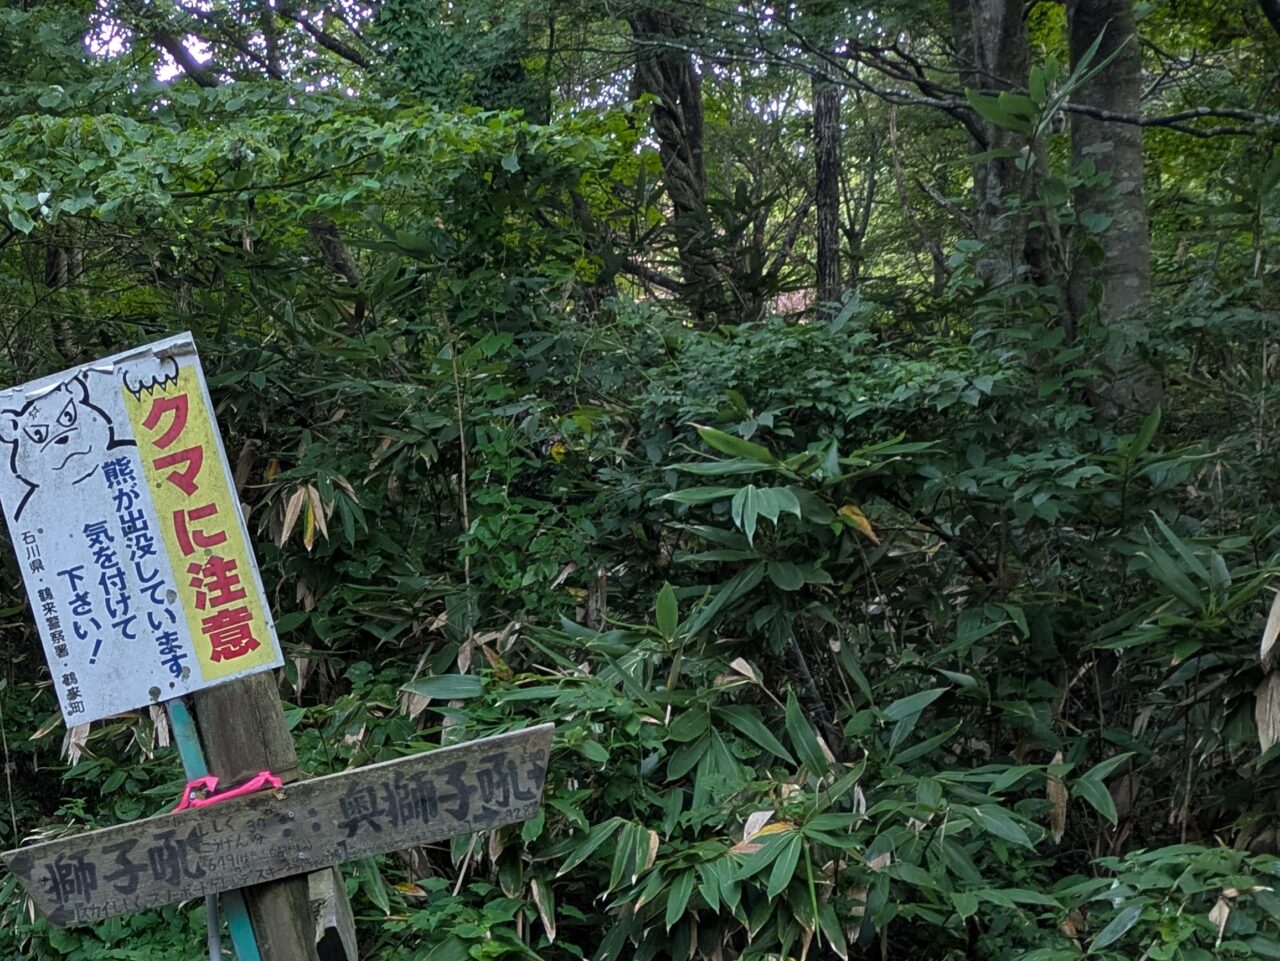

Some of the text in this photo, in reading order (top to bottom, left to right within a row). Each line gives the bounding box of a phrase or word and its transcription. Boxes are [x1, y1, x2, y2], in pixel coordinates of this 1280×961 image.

[141, 392, 261, 664] クマに注意
[56, 563, 104, 665] 下さい！
[82, 519, 138, 640] 気を付けて
[339, 752, 537, 839] 奥獅子吼
[41, 829, 207, 904] 獅子吼
